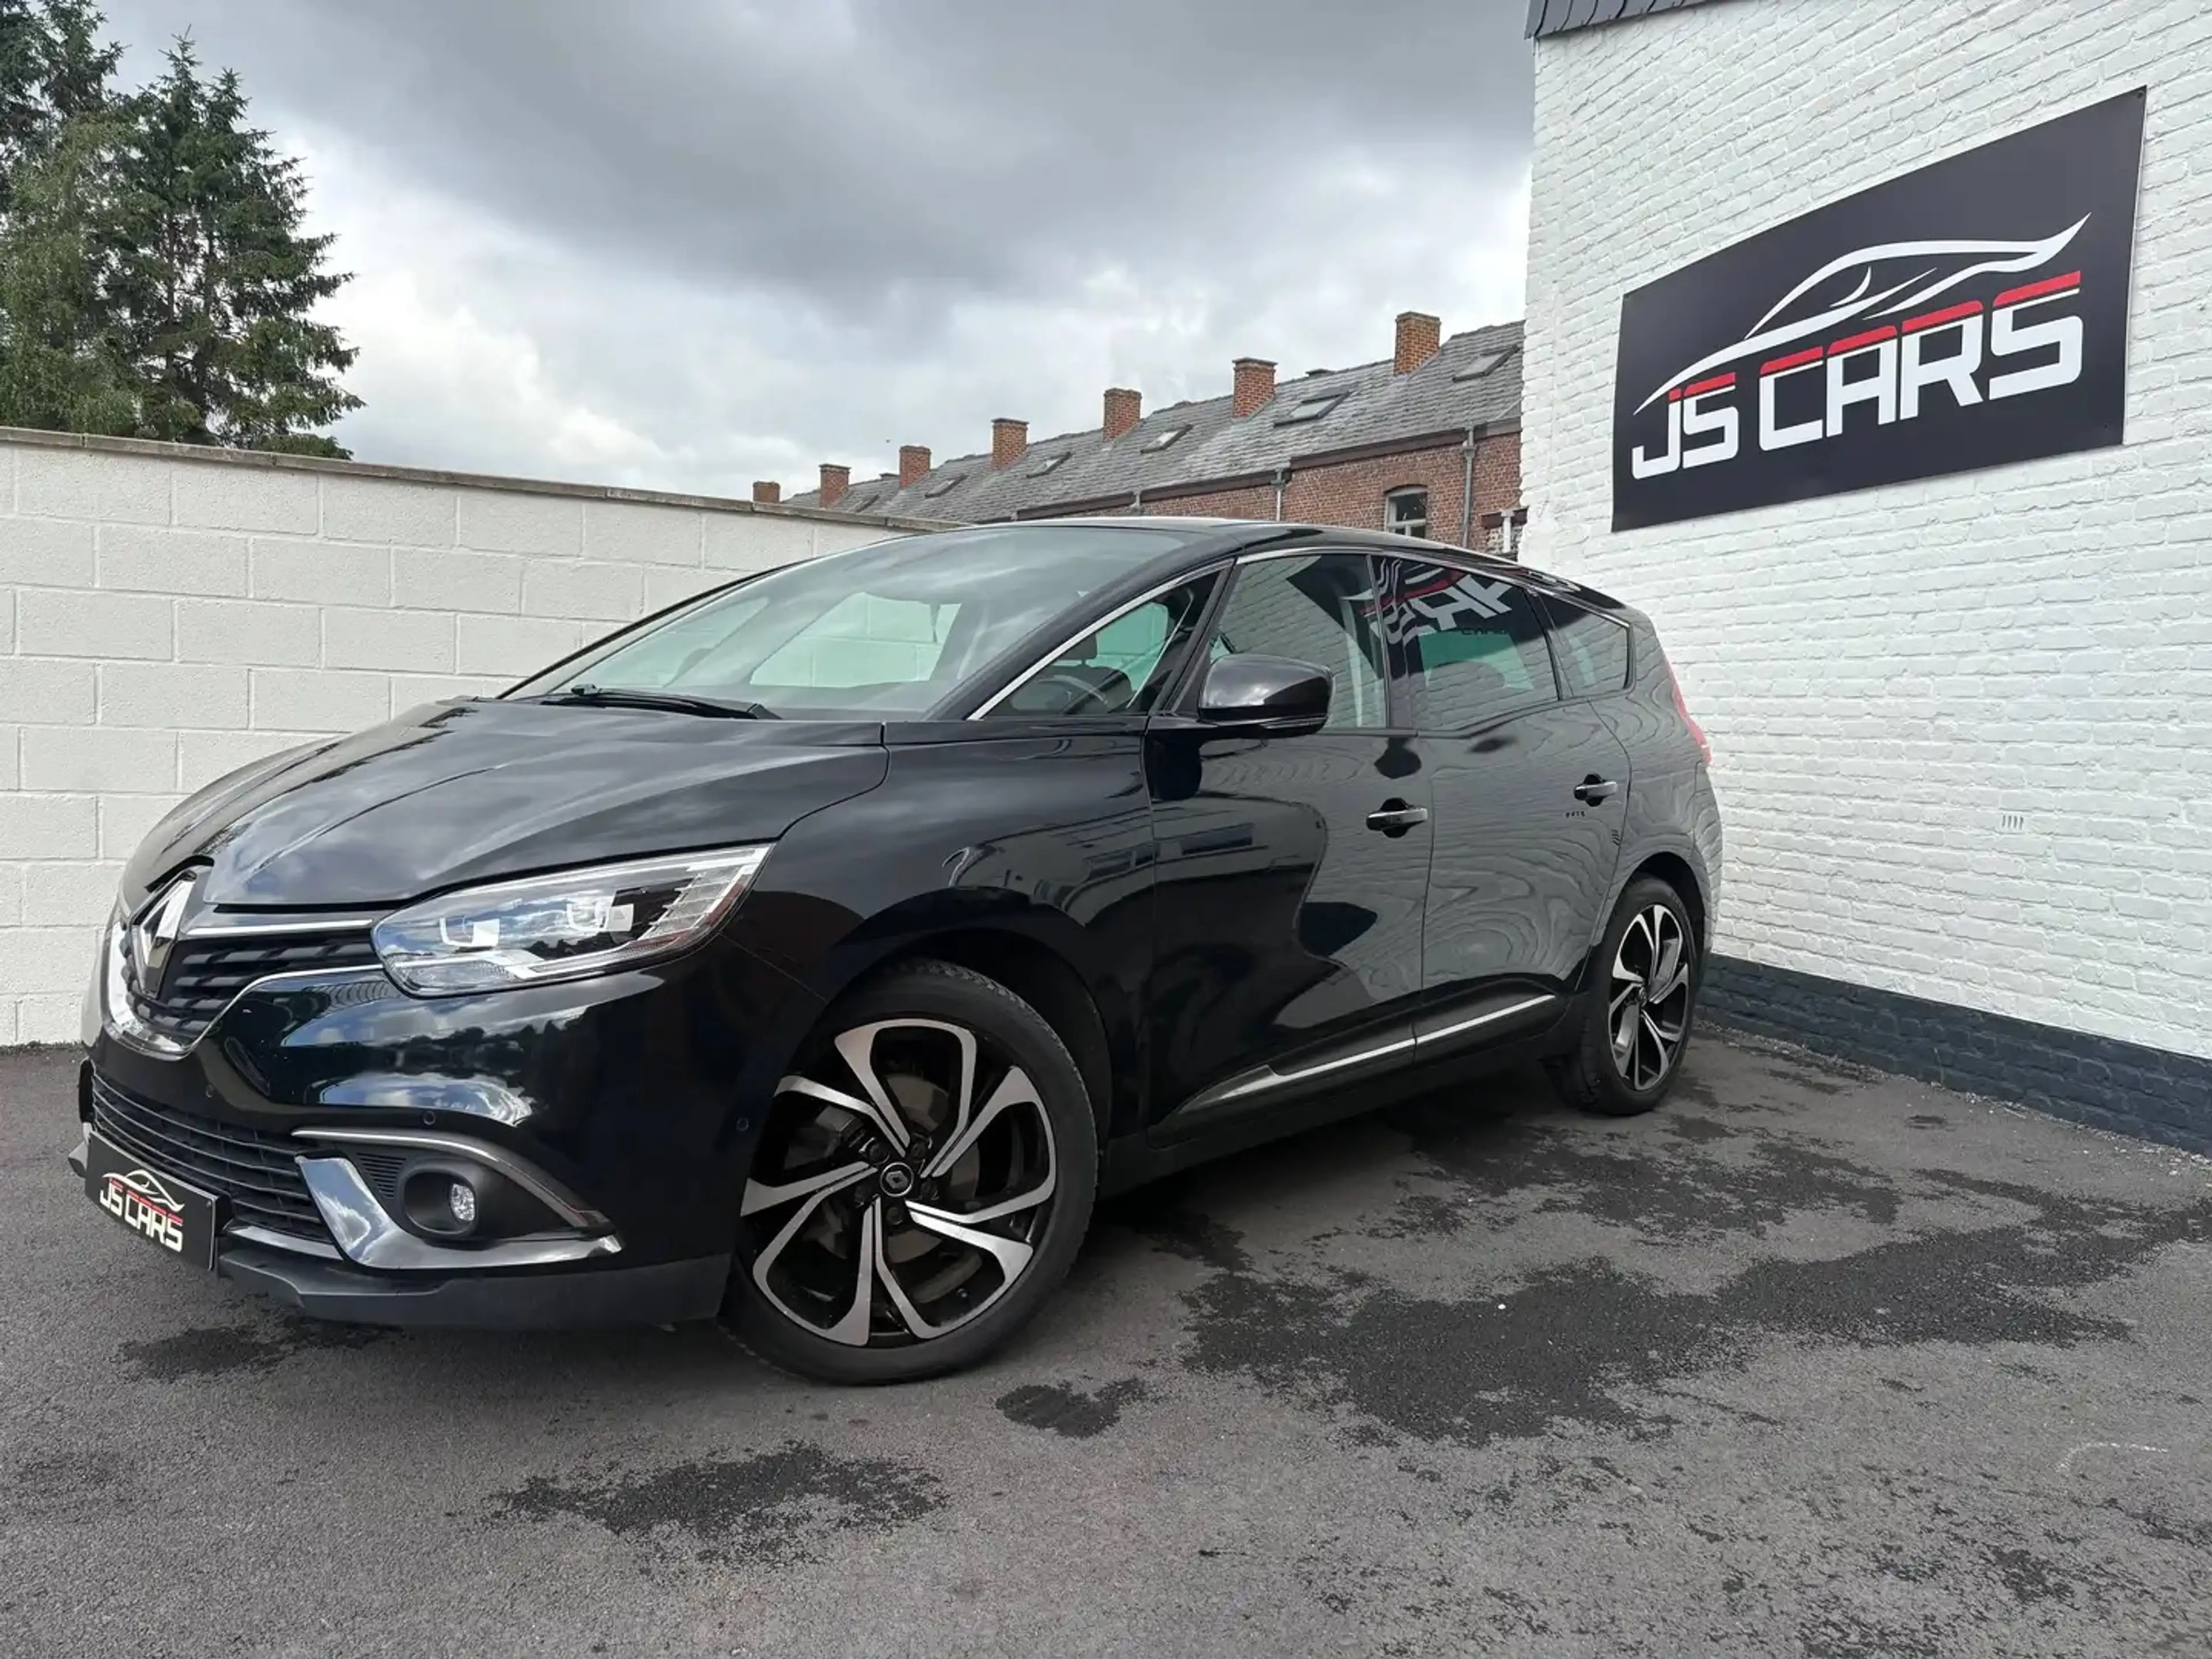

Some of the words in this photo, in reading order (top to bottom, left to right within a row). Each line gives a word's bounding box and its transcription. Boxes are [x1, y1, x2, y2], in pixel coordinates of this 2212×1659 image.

[1631, 372, 1738, 479] JS
[1759, 271, 2083, 450] CARS
[100, 1179, 123, 1217] JS
[124, 1191, 183, 1252] CARS
